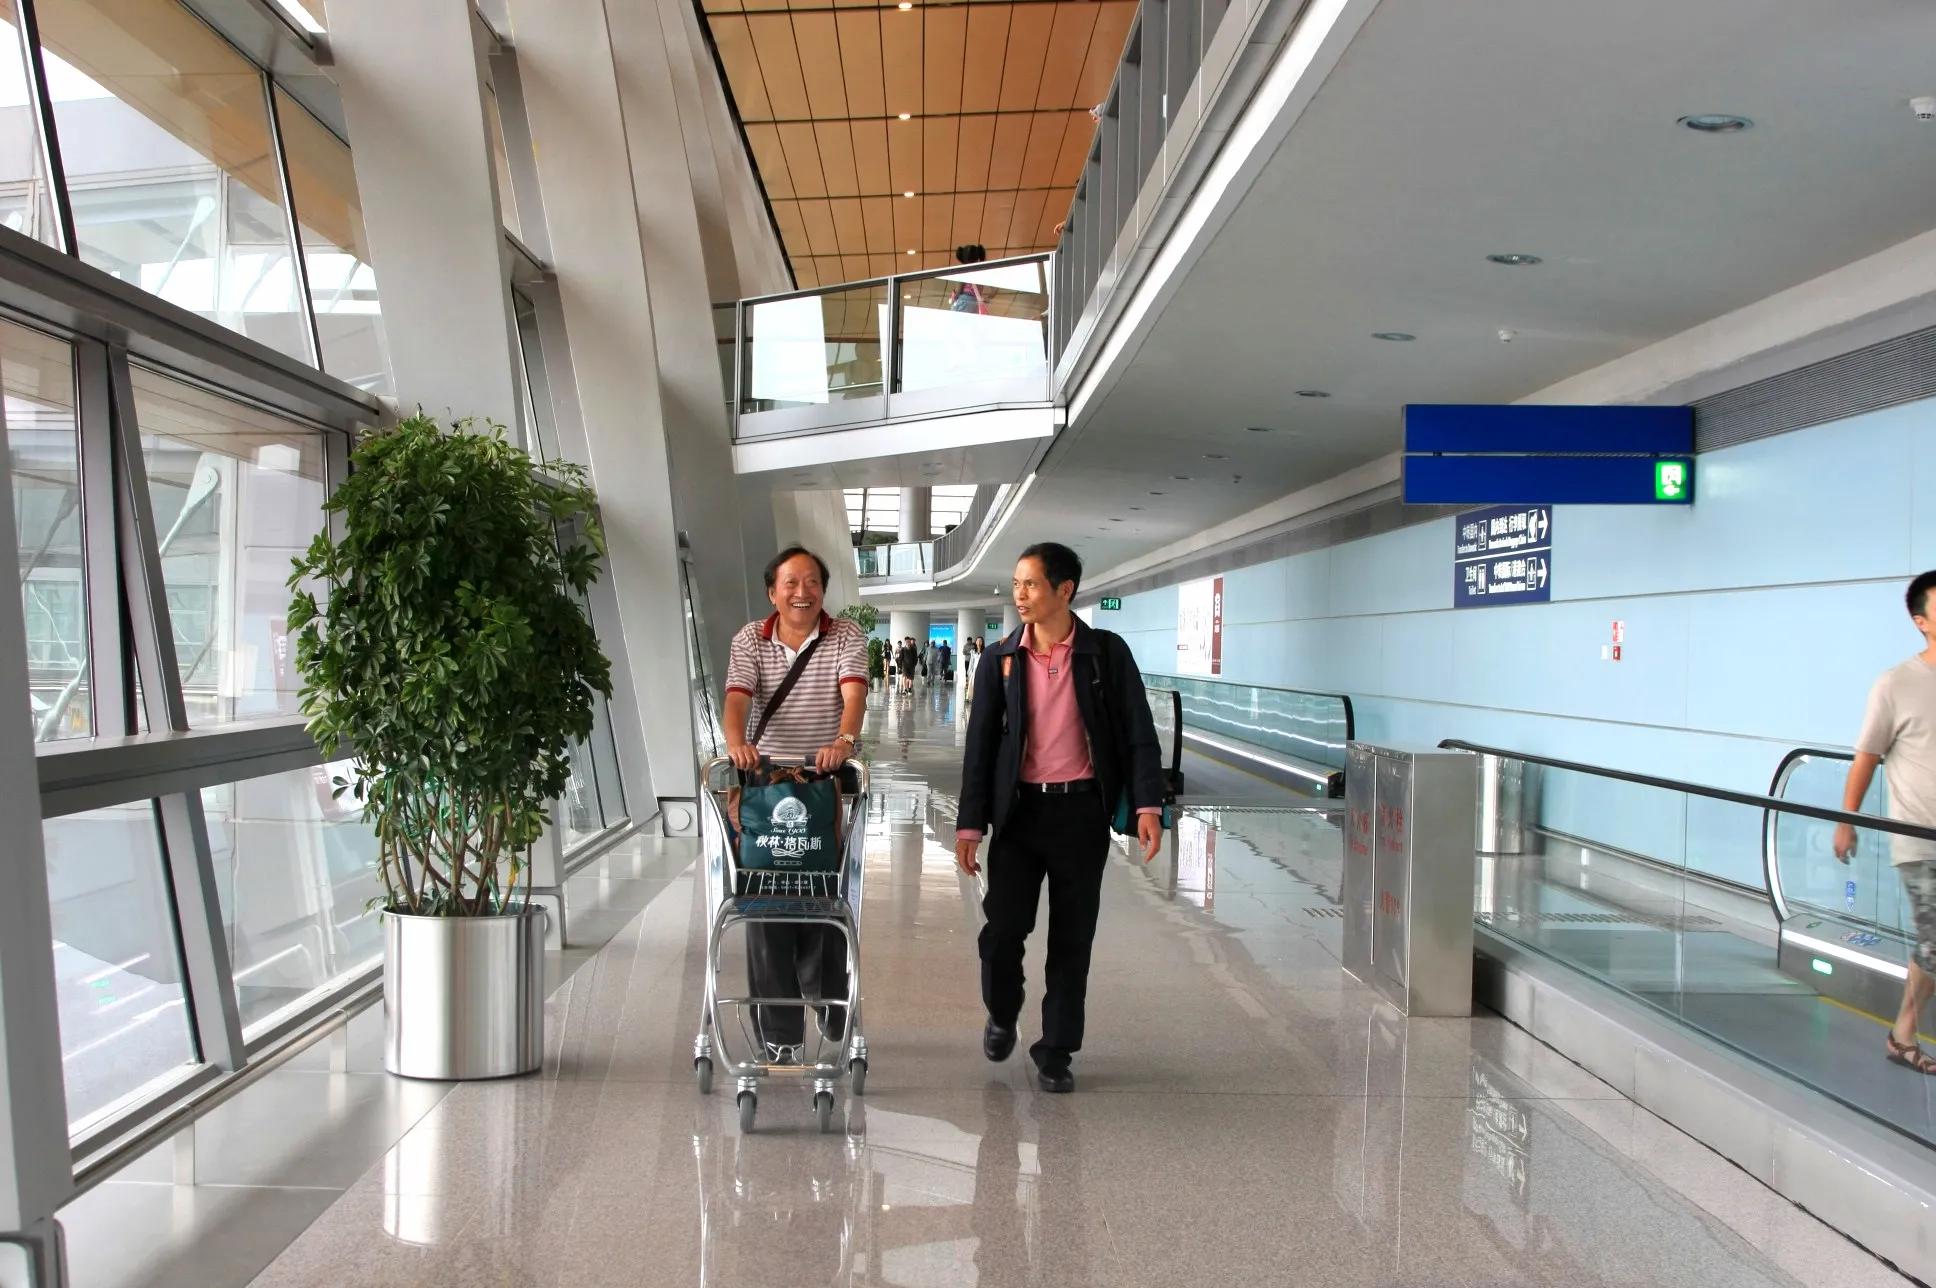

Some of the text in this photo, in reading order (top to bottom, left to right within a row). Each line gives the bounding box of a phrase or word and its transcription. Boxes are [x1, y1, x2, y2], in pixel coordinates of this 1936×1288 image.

[755, 835, 822, 851] 秋林·格瓦斯
